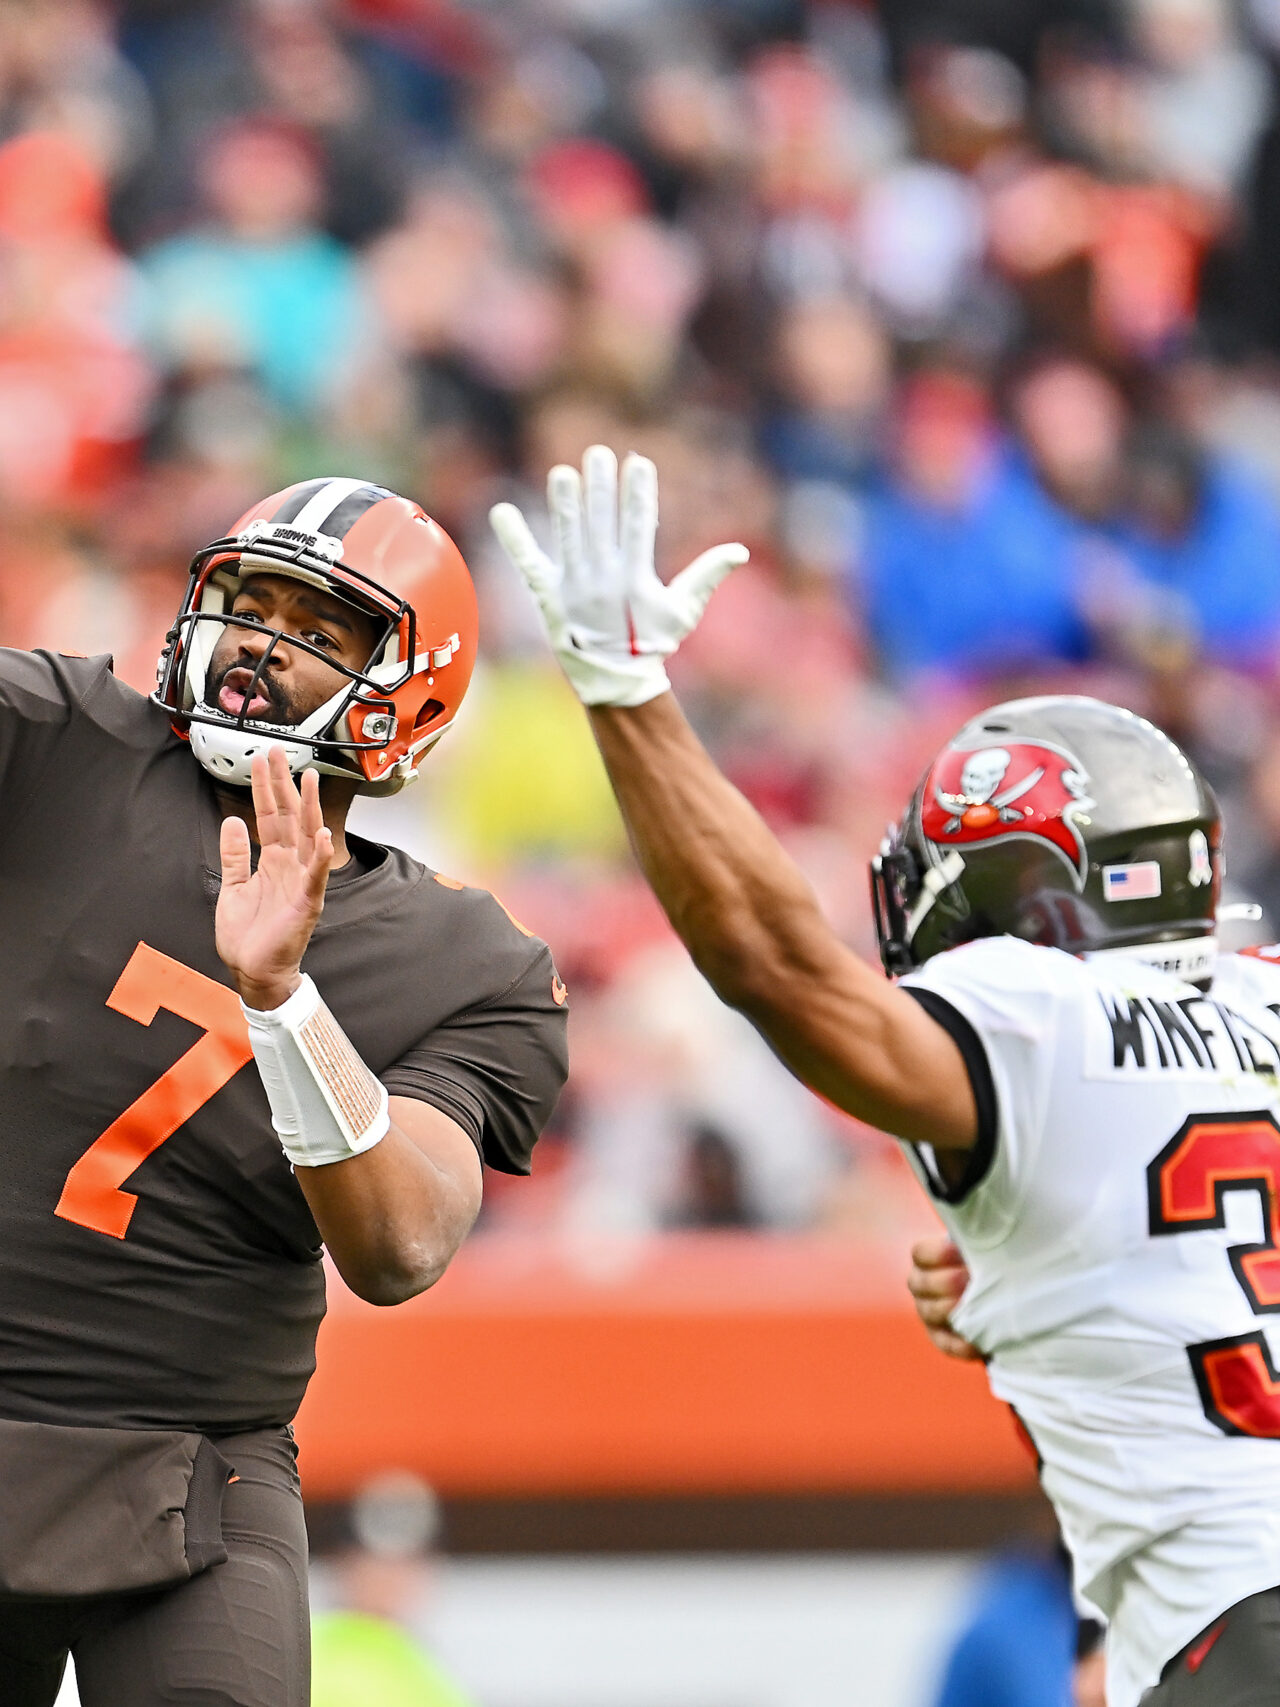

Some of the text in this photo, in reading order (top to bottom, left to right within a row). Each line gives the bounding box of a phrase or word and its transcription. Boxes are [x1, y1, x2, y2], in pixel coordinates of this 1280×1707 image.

[272, 527, 318, 547] BROWNS
[54, 940, 255, 1240] 7
[1146, 1110, 1280, 1440] 3
